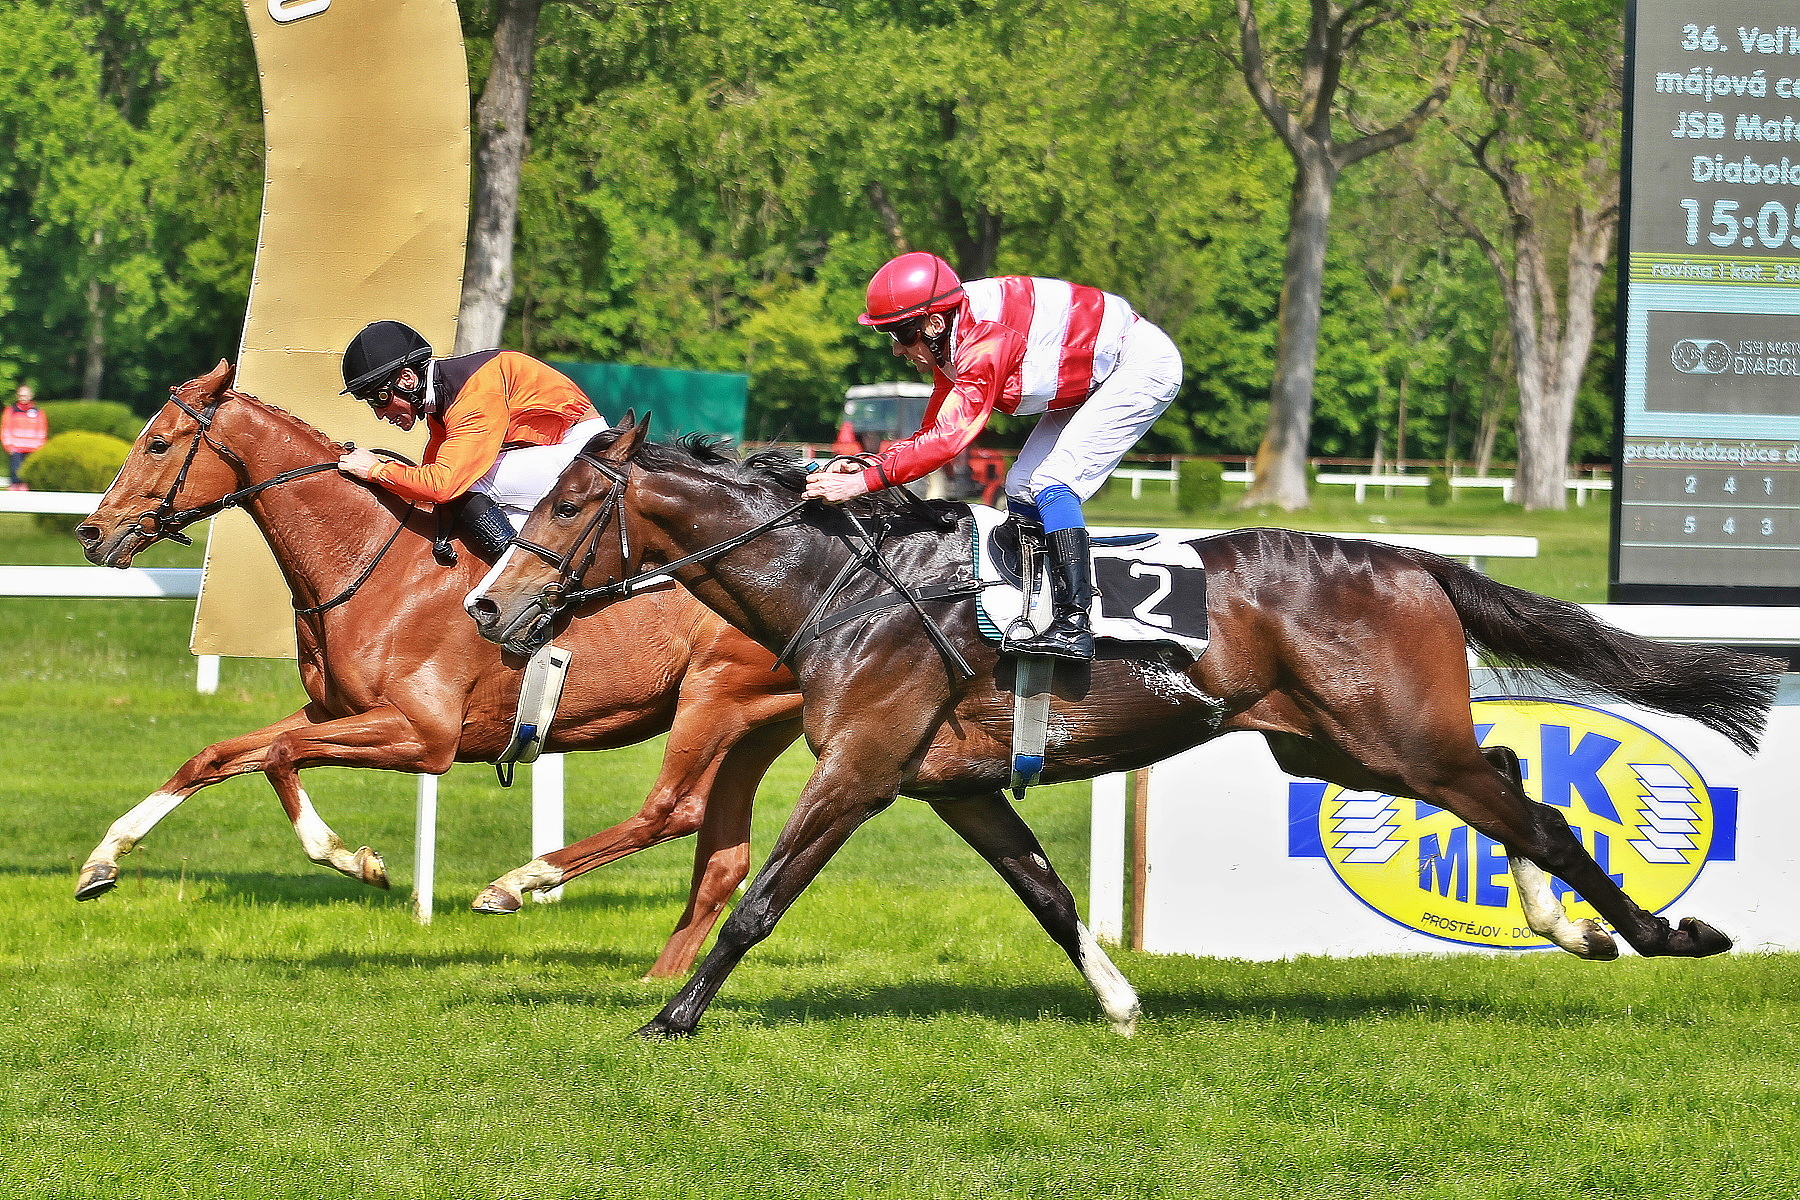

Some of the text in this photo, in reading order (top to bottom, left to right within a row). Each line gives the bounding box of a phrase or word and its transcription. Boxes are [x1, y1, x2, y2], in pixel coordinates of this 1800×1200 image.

[1681, 23, 1728, 52] 36.
[1655, 65, 1767, 103] májová
[1671, 110, 1726, 139] JSB
[1651, 259, 1714, 280] rovina
[1784, 443, 1800, 464] d
[1684, 474, 1774, 496] 2 4 1
[1682, 514, 1697, 535] 5
[1721, 515, 1737, 536] 4
[1759, 516, 1775, 537] 3
[1129, 561, 1173, 629] 2
